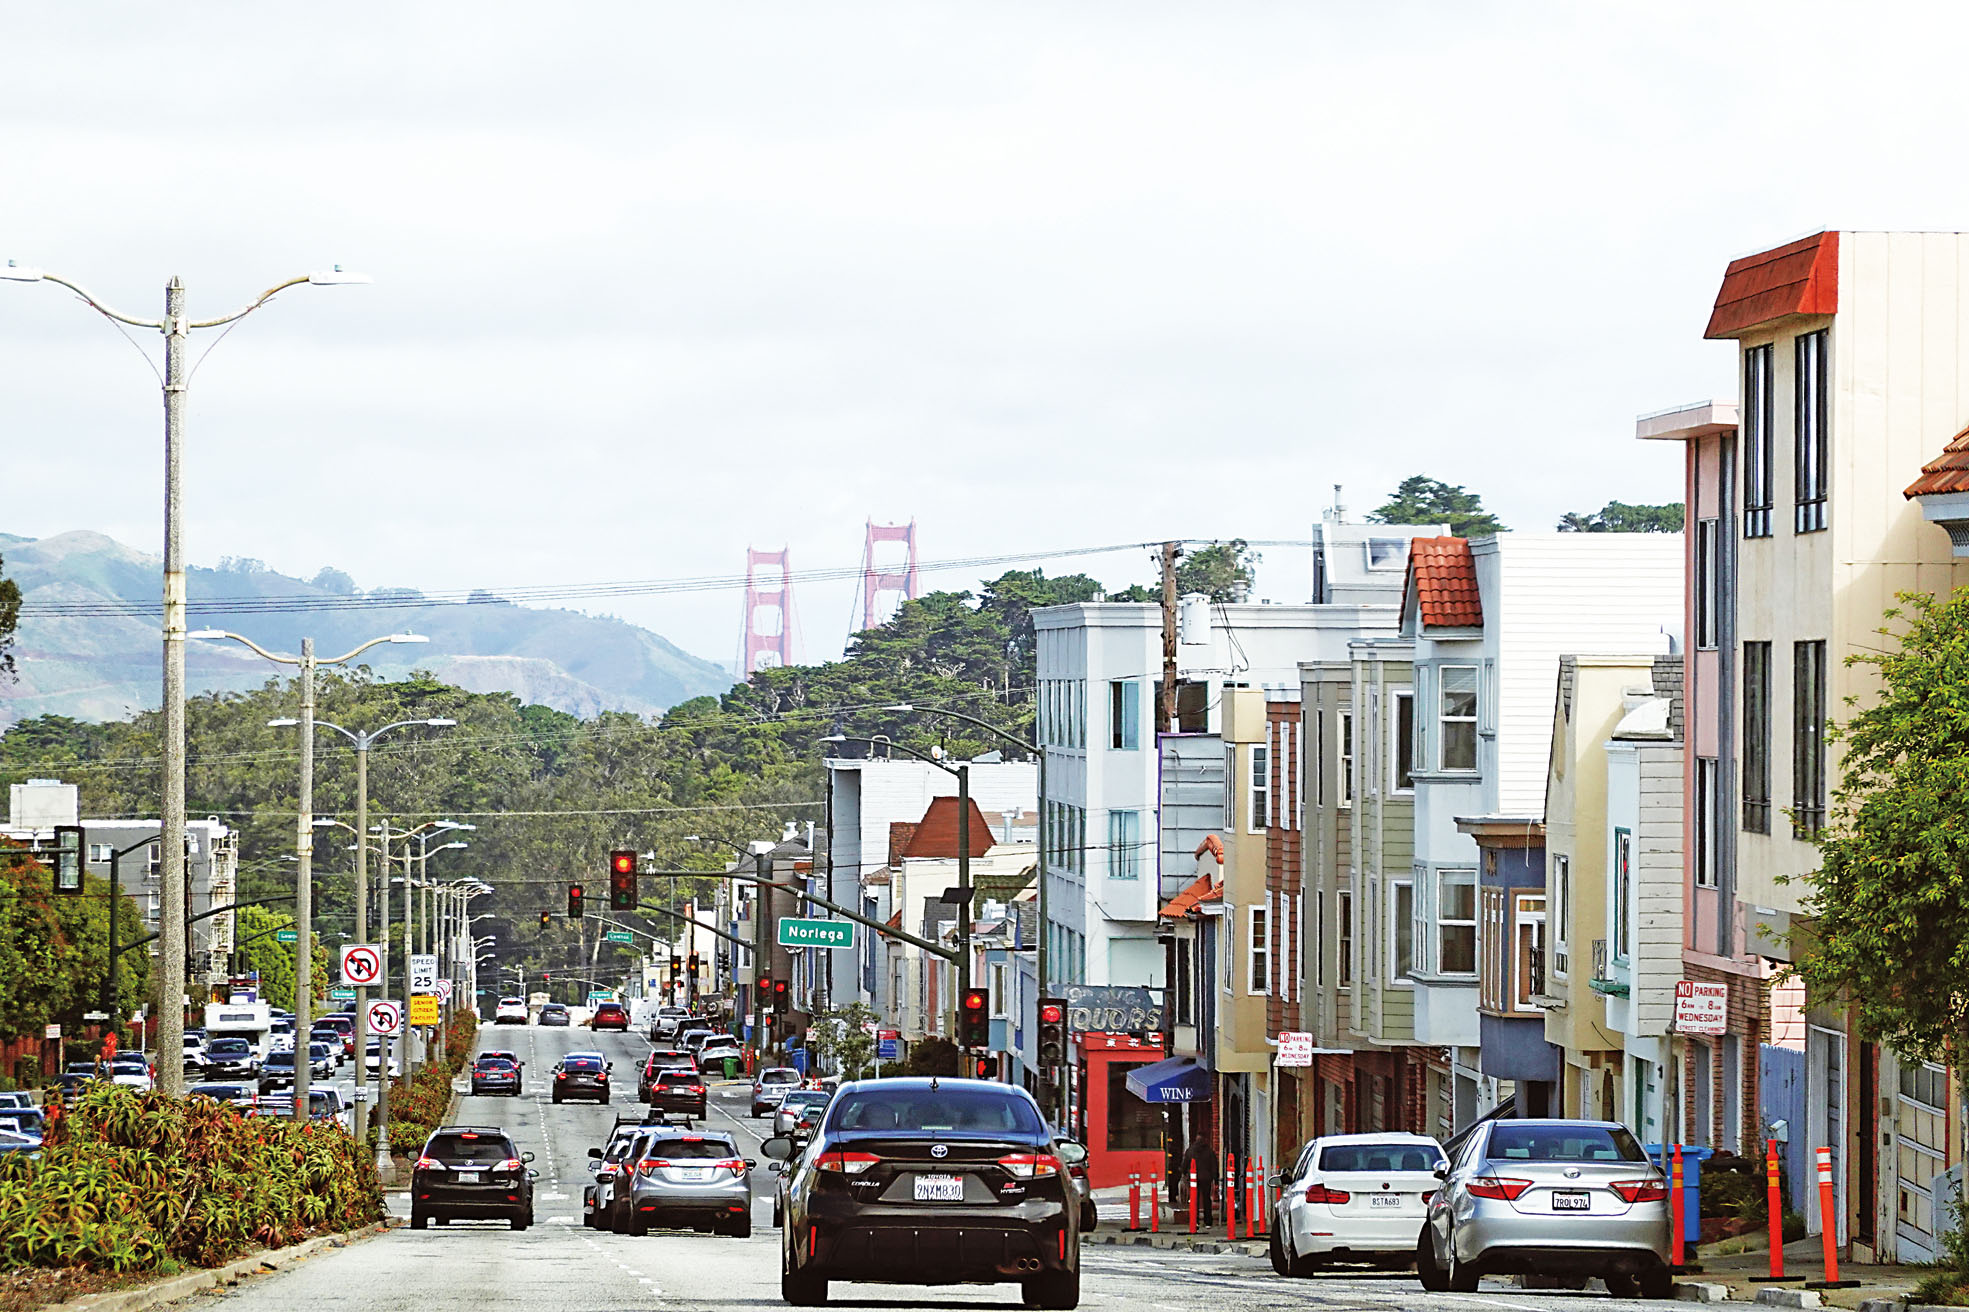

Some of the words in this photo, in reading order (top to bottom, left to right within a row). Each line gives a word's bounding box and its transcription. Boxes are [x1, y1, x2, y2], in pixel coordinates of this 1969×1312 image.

[414, 976, 432, 987] 25
[1678, 983, 1691, 996] NO
[1694, 986, 1725, 997] PARKING
[1678, 1013, 1723, 1022] WEDNESDAY
[1280, 1034, 1289, 1042] NO
[1160, 1087, 1194, 1100] WINE
